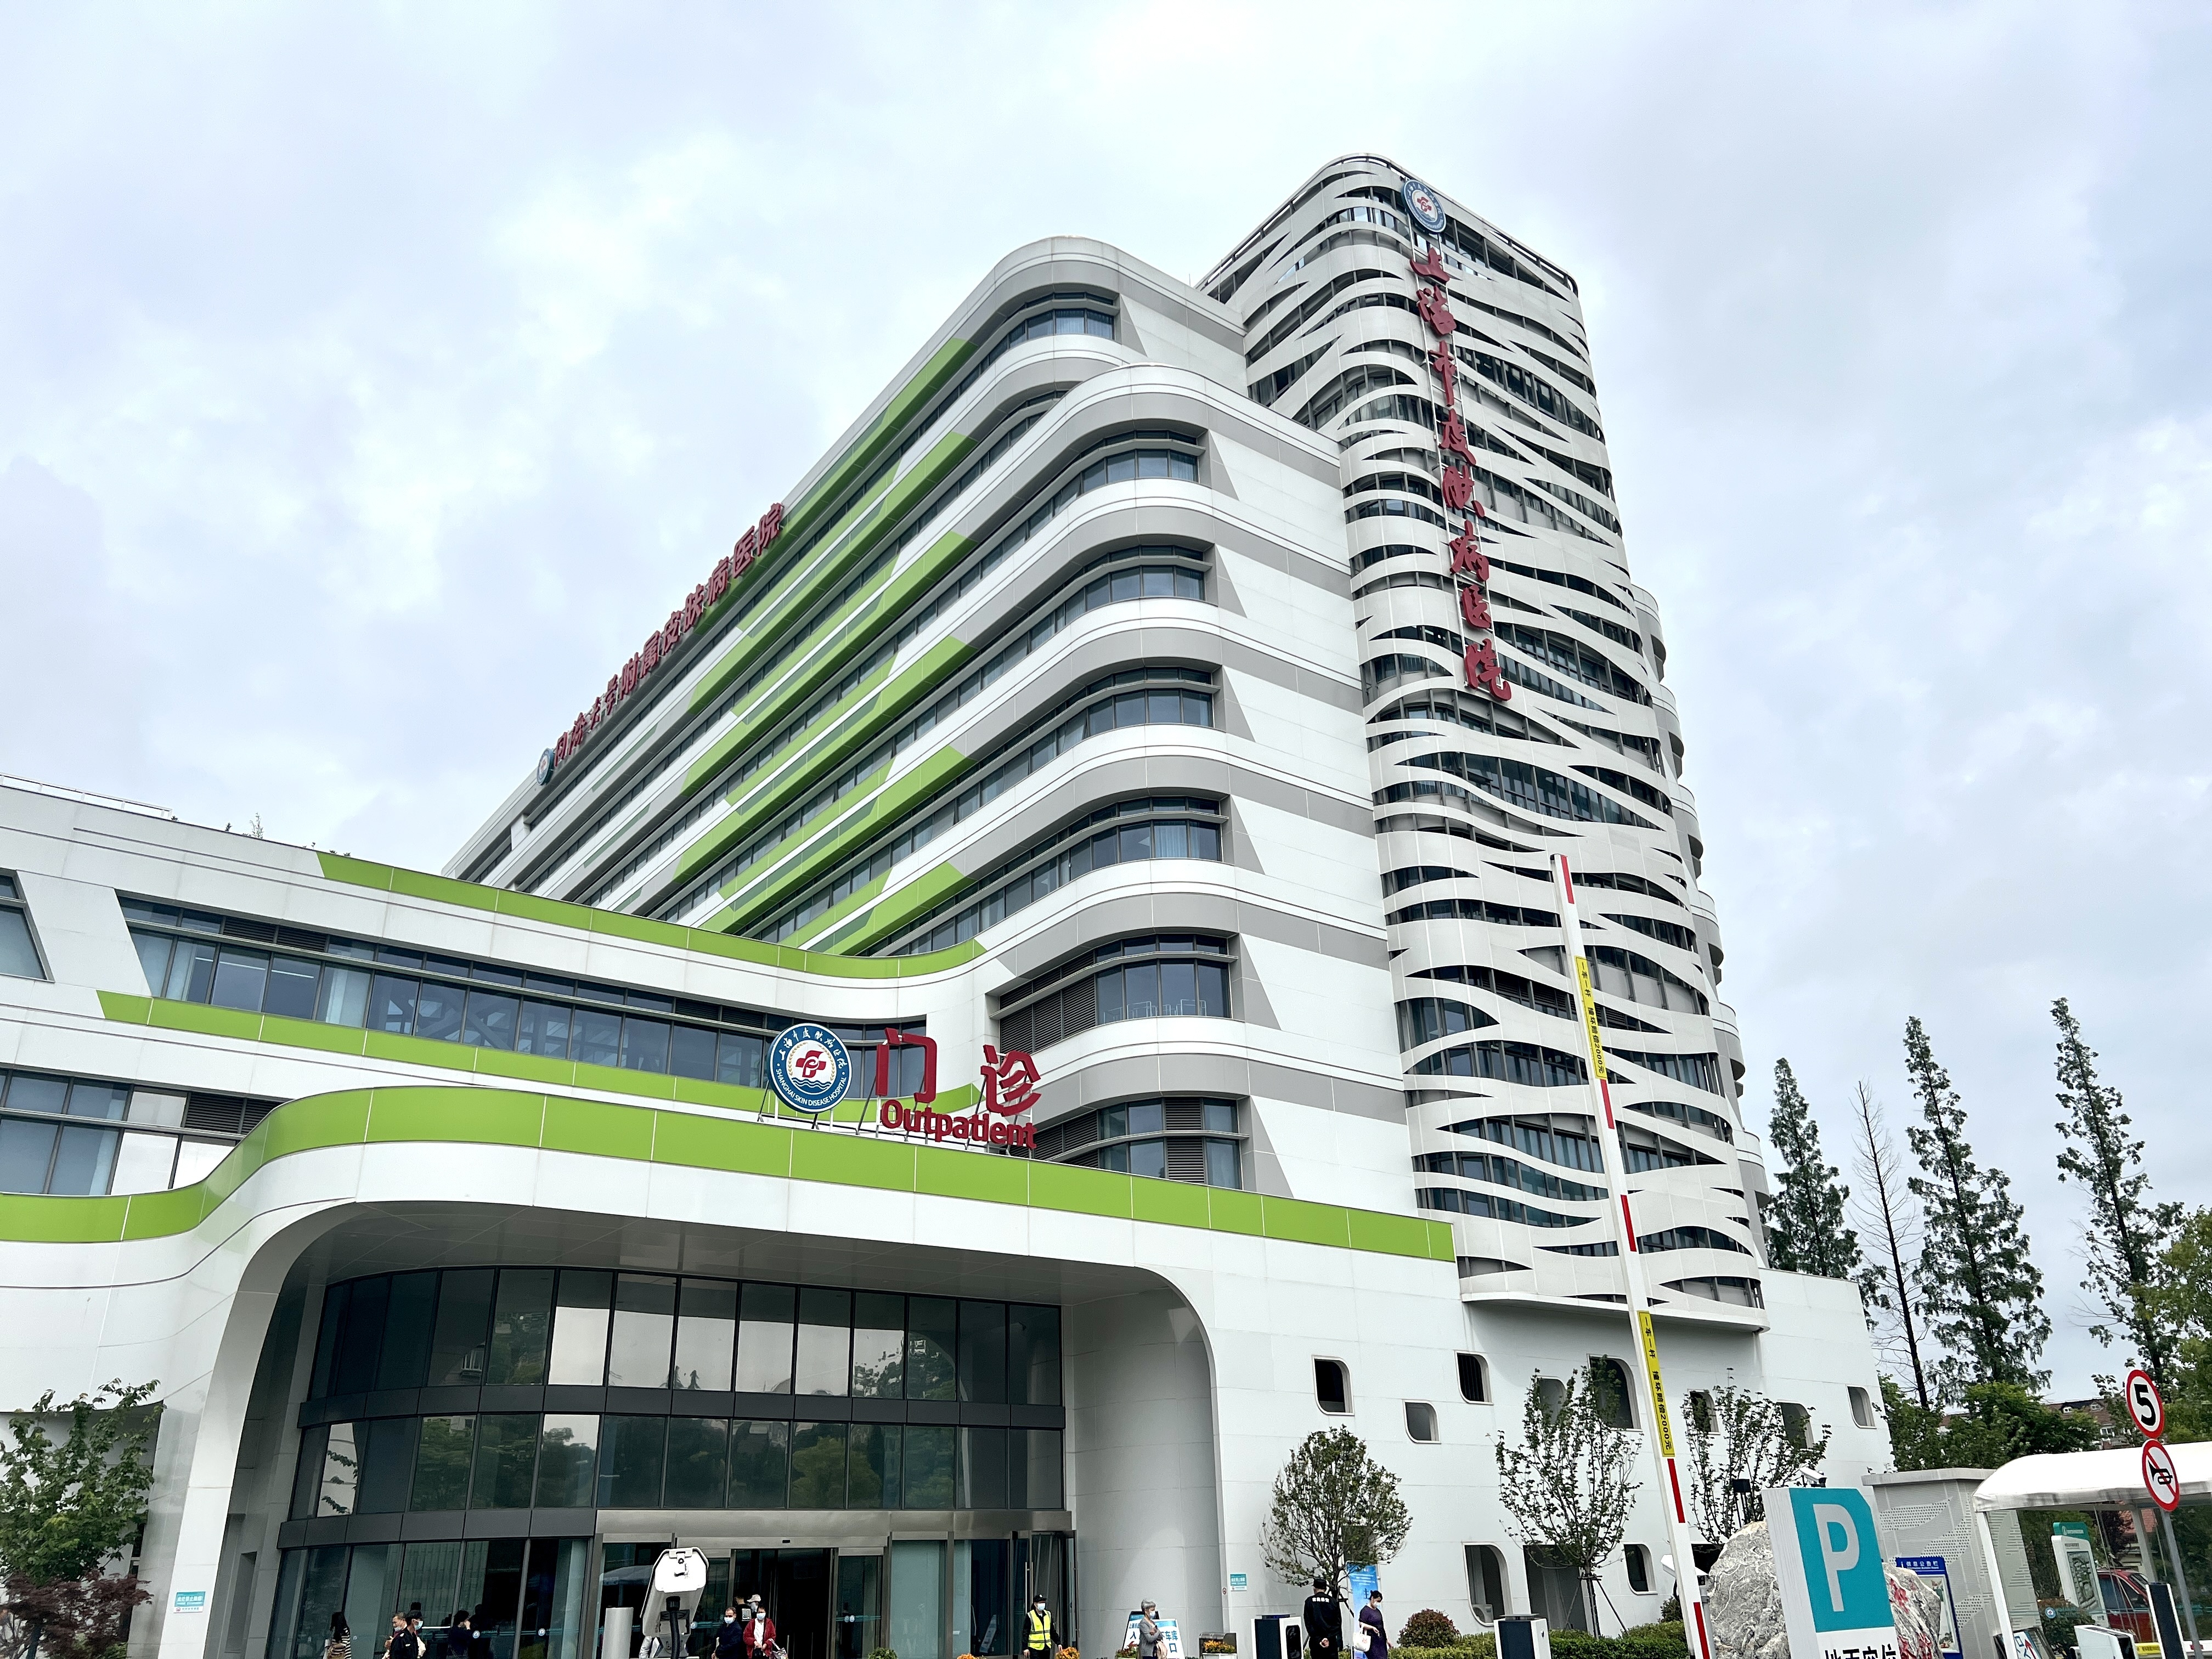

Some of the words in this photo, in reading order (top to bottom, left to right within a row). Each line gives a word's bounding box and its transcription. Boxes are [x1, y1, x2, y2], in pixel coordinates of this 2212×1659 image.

[1409, 247, 1511, 702] 上海市皮肤病医院
[554, 503, 782, 768] 同济大学附属皮肤病医院
[776, 1069, 795, 1098] SHANGHAI
[794, 1095, 808, 1105] SKIN
[808, 1097, 831, 1106] DISEASE
[829, 1077, 847, 1102] HOSPITAL
[875, 1027, 1042, 1117] 门诊
[881, 1099, 1037, 1149] Outpatient
[2133, 1383, 2156, 1426] 5
[1813, 1504, 1860, 1612] P
